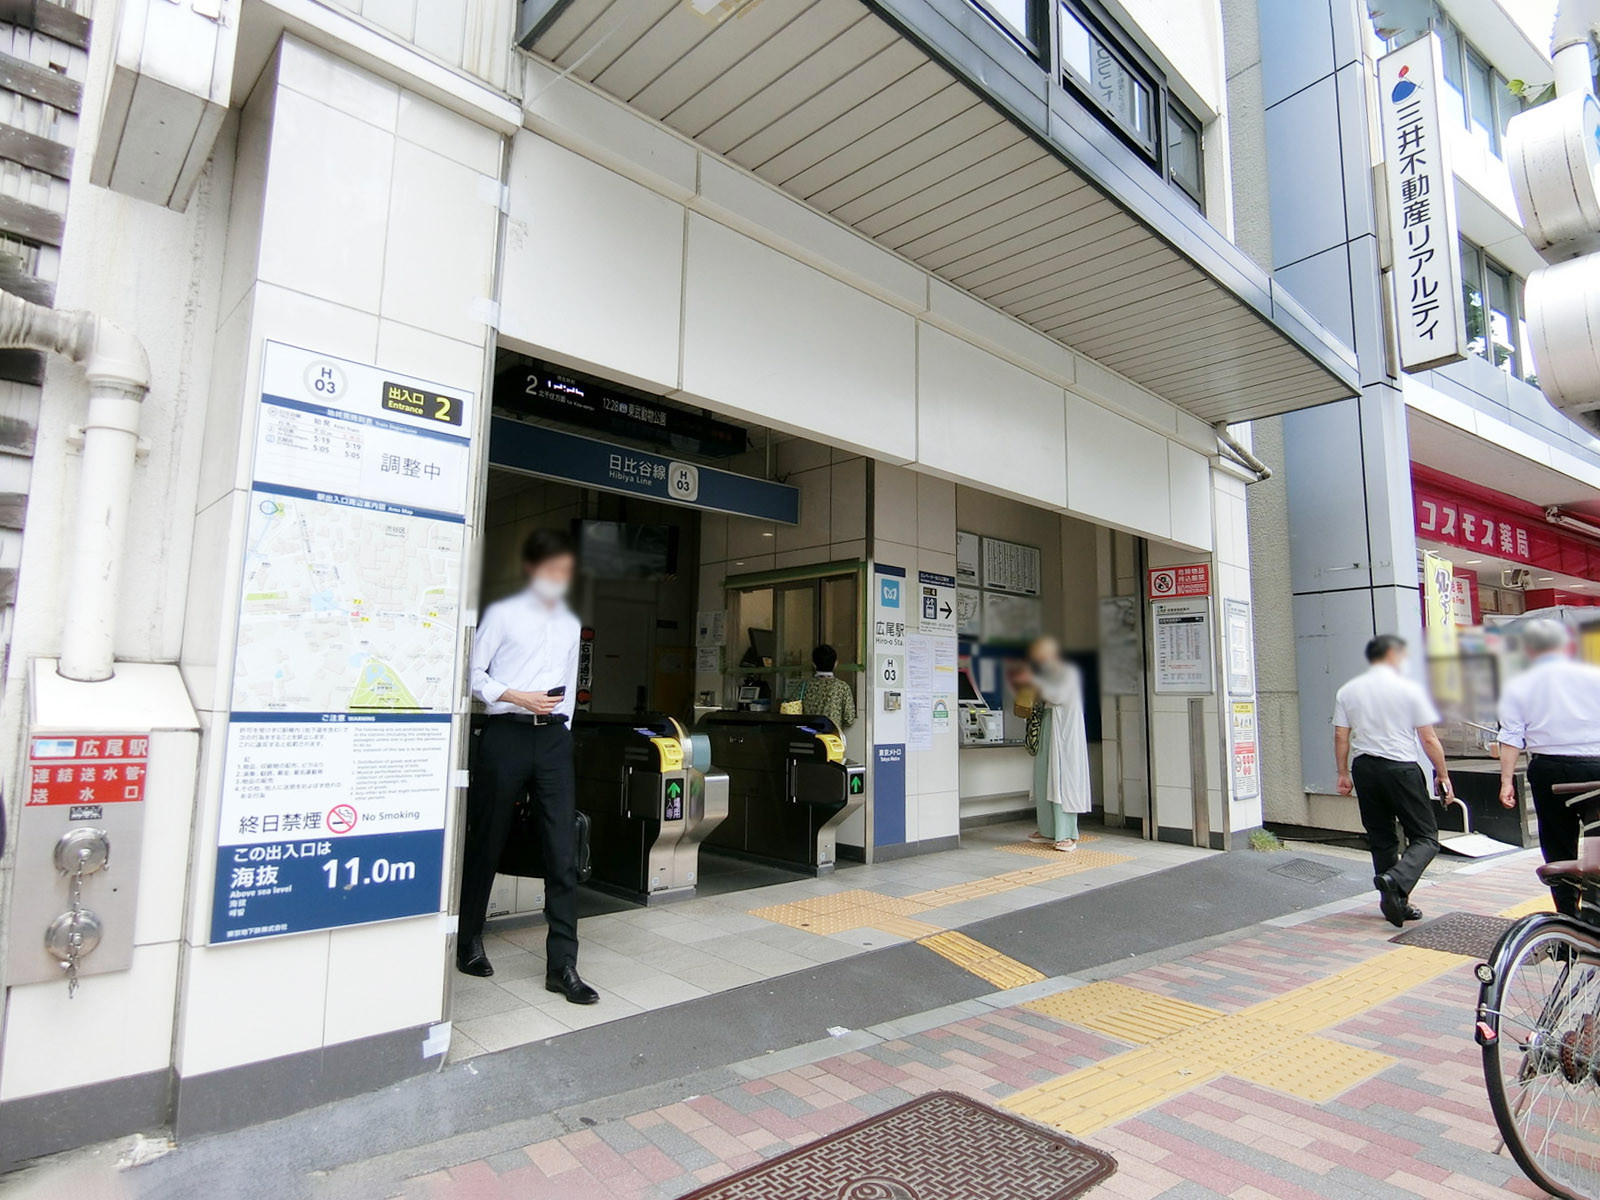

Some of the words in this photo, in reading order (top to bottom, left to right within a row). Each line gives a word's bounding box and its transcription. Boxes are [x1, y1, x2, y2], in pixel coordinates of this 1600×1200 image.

[1396, 99, 1440, 340] 三井不動産リアルティ
[321, 366, 332, 379] H
[314, 378, 336, 394] 03
[525, 374, 538, 395] 2
[388, 386, 424, 406] 出入口
[388, 400, 424, 415] Entrance
[434, 396, 451, 421] 2
[628, 403, 667, 427] 東武動物公園
[381, 453, 441, 481] 調整中
[609, 454, 666, 480] 日比谷線
[680, 470, 688, 480] H
[609, 470, 635, 483] Hibiya
[636, 476, 653, 487] Line
[677, 480, 690, 492] 03
[1420, 500, 1529, 559] コスモス薬局
[876, 621, 905, 637] 広尾駅
[887, 659, 894, 668] H
[884, 669, 896, 681] 03
[80, 739, 148, 757] 広尾駅
[238, 812, 322, 835] 終日禁煙
[362, 813, 376, 822] No
[378, 810, 421, 821] Smoking
[233, 841, 332, 863] この出入口は
[230, 865, 280, 889] 海抜
[322, 856, 416, 889] 11.0m
[230, 890, 256, 899] Above
[272, 885, 293, 894] level
